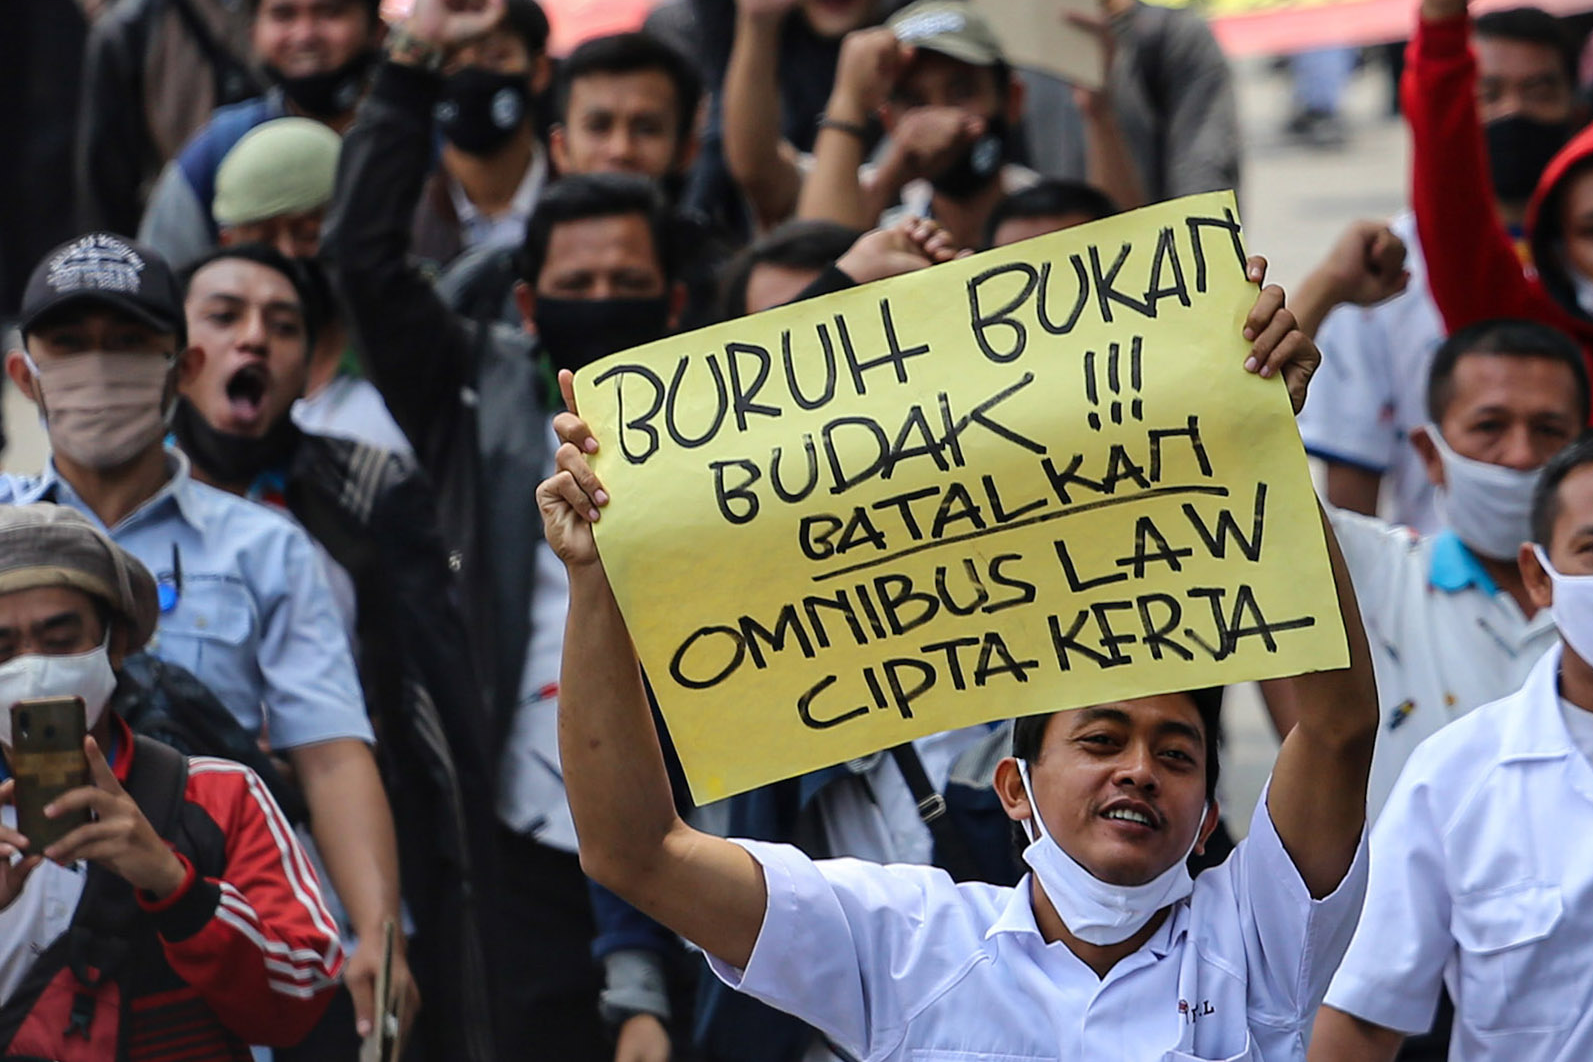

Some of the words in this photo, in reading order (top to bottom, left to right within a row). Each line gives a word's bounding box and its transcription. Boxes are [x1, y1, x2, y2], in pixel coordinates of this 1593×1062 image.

[594, 299, 929, 465] BURUH
[967, 210, 1251, 364] BUKAN
[710, 372, 1047, 524] BUDAK
[1084, 336, 1144, 431] !!!
[799, 415, 1214, 561] BATALKAN
[669, 553, 1037, 690] OMNIBUS
[1054, 482, 1268, 593] LAW
[797, 632, 1039, 730] CIPTA
[1048, 584, 1316, 672] KERJA
